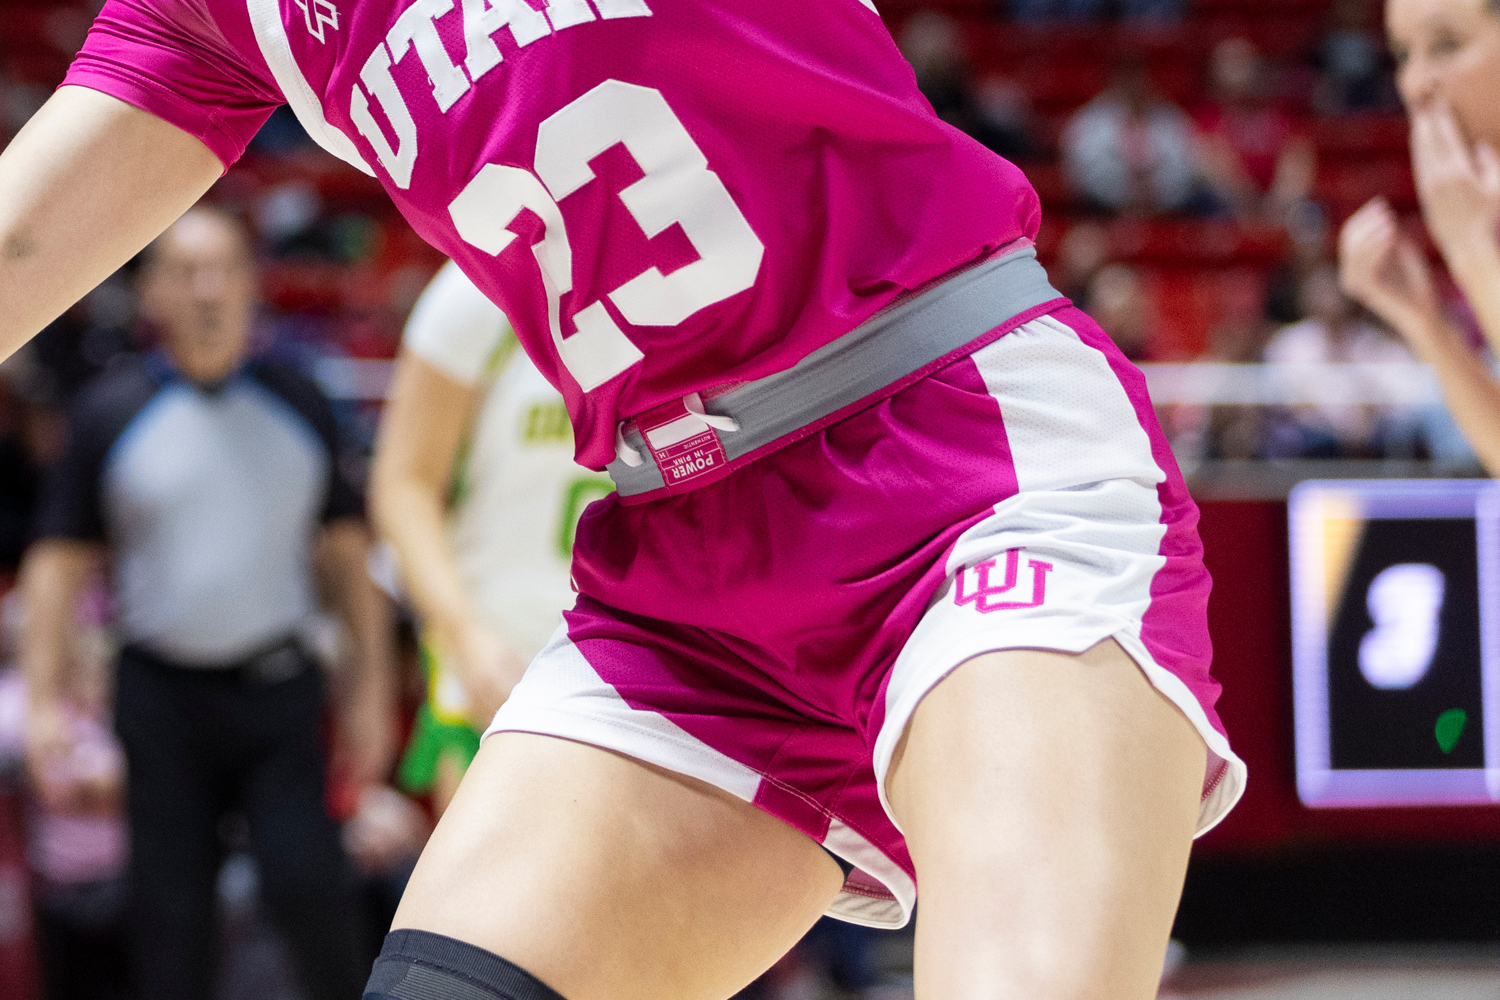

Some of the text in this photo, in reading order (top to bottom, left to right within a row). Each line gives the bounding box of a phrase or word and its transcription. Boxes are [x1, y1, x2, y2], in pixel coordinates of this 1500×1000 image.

[448, 78, 765, 393] 23
[683, 435, 711, 450] AUTHENTIC
[671, 453, 714, 479] POWER
[672, 449, 704, 466] IN PINK
